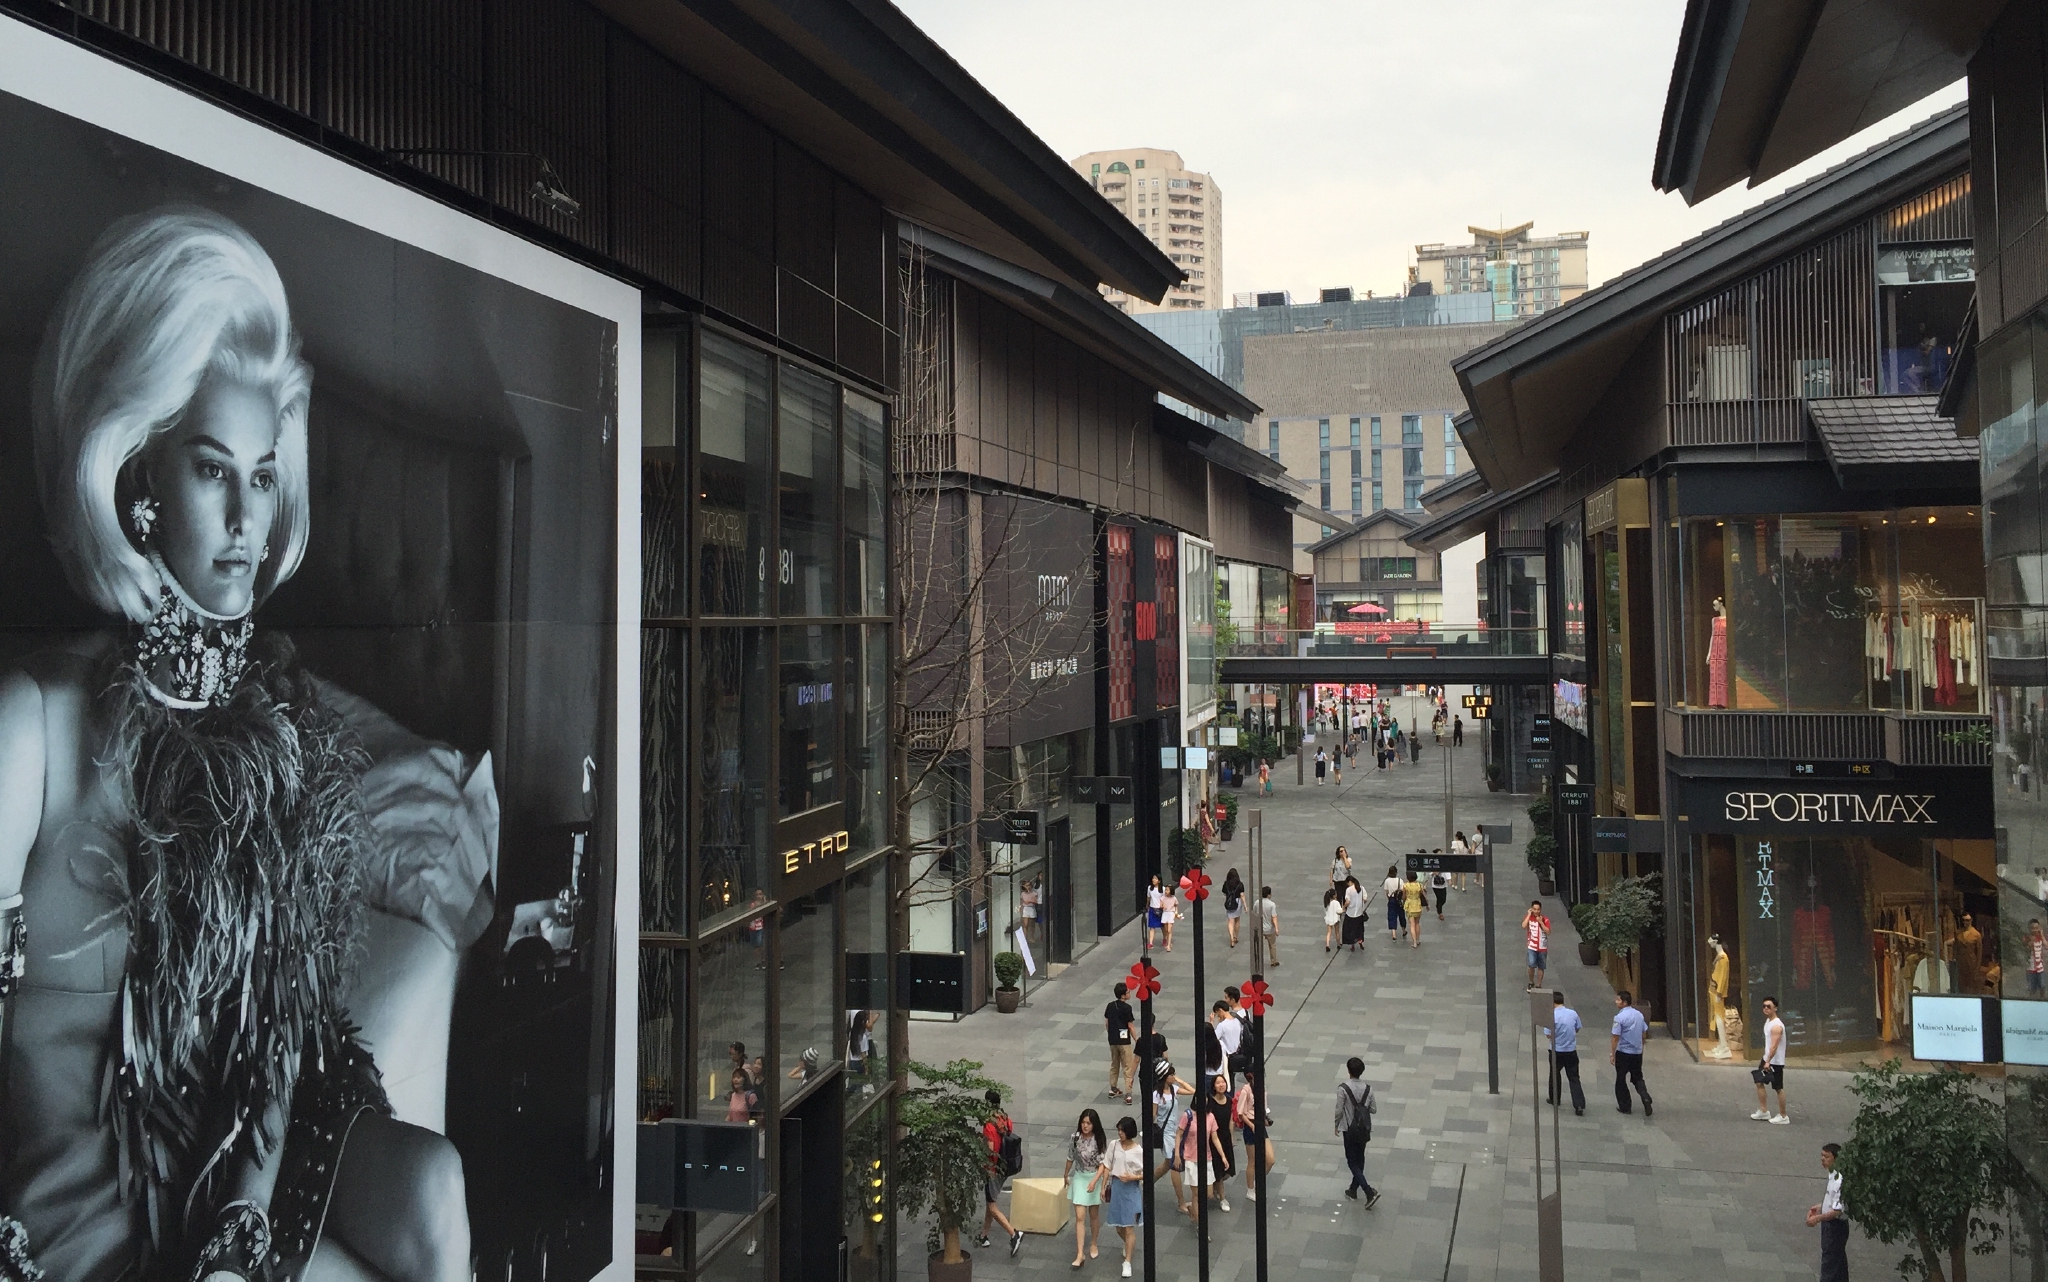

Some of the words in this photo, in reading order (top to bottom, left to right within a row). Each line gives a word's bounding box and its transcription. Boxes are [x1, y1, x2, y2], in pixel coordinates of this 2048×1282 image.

[1930, 248, 1950, 258] Hair
[1852, 765, 1871, 774] 中区
[1725, 791, 1938, 823] SPORTMAX
[1917, 1022, 1944, 1031] Maison
[1946, 1024, 1978, 1033] Margiela
[684, 1162, 745, 1172] ETRO
